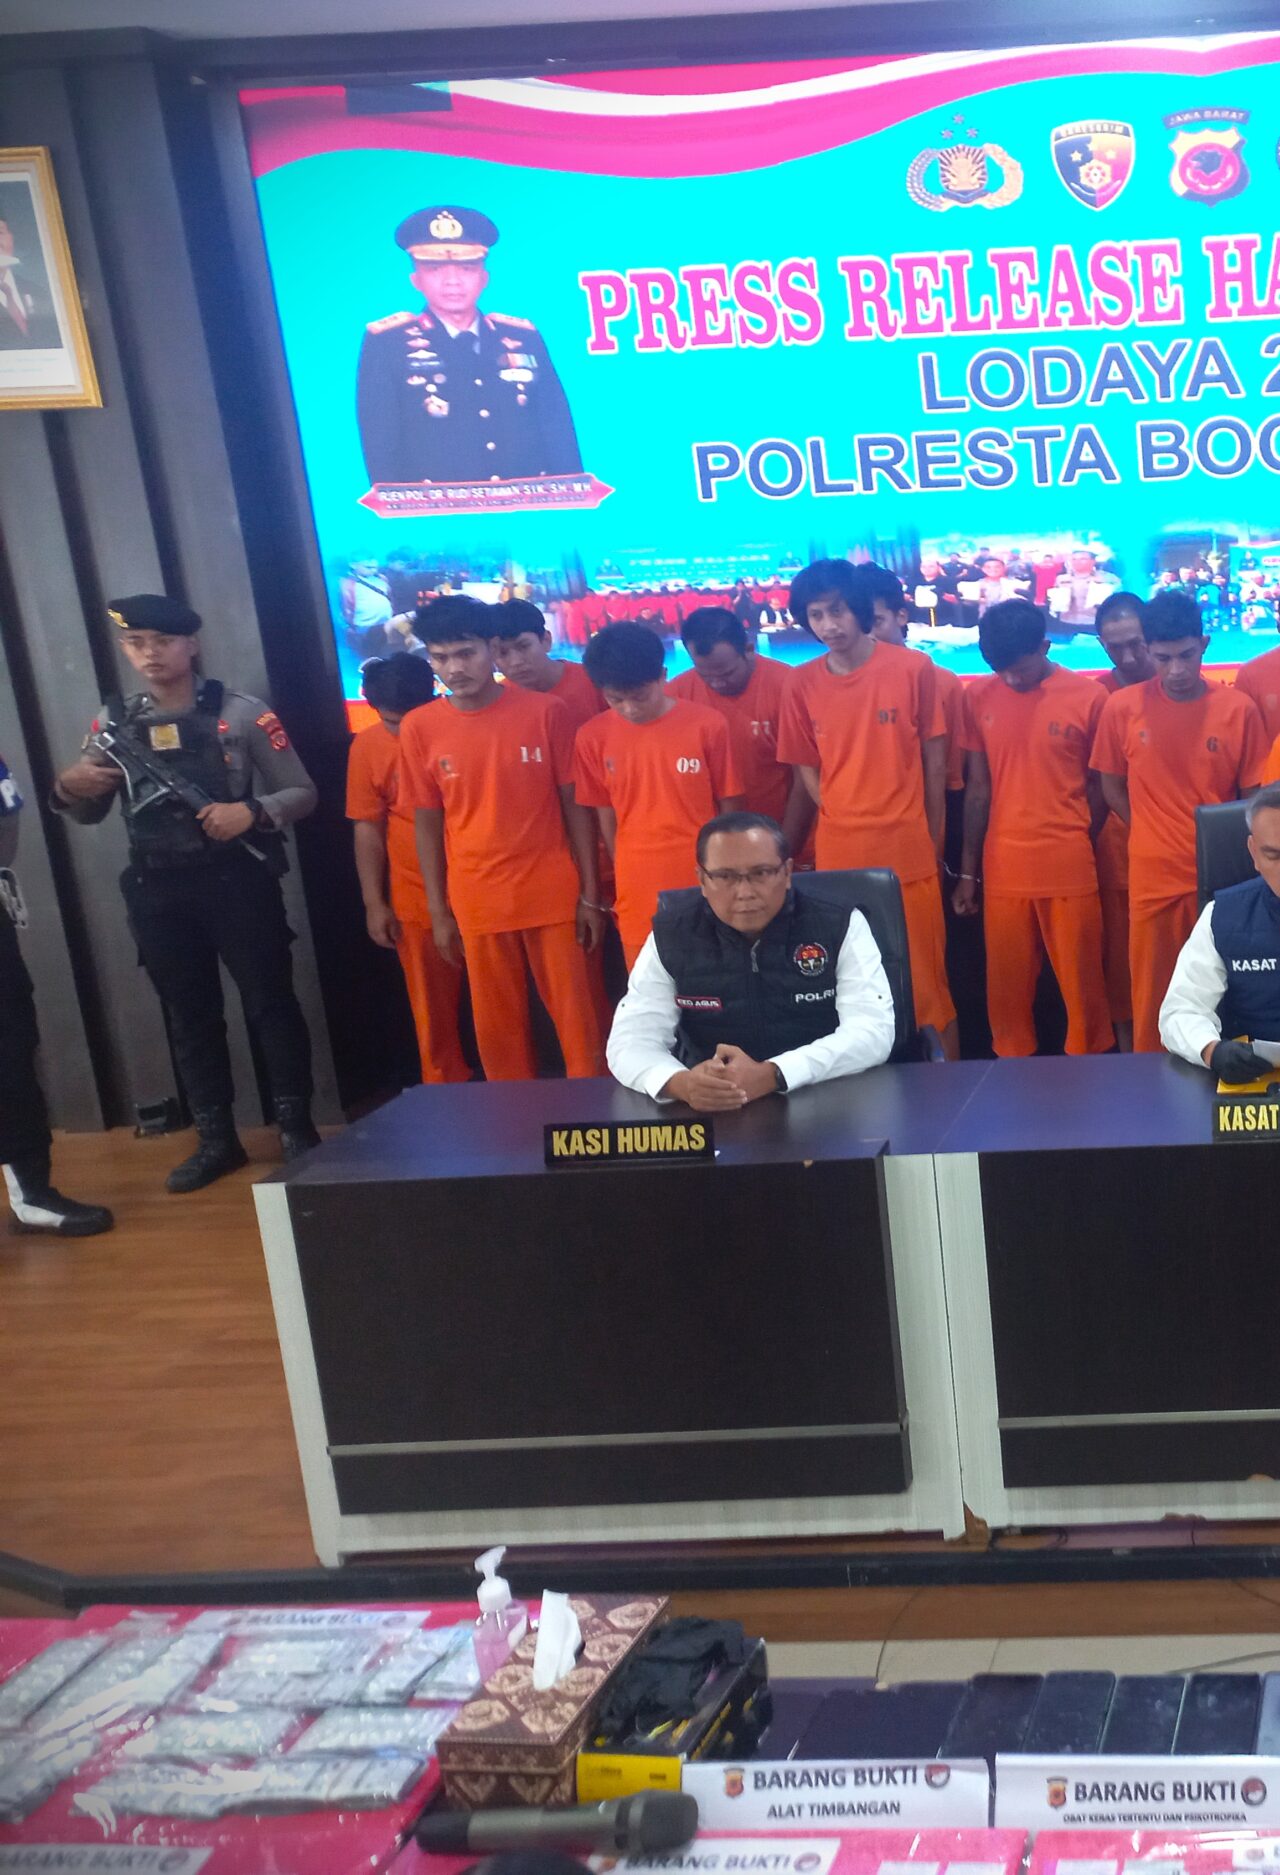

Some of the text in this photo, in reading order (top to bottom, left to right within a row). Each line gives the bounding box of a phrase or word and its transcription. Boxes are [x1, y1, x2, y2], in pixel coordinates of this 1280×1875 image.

[581, 257, 823, 353] PRESS
[838, 242, 1184, 341] RELEASE
[919, 338, 1244, 413] LODAYA
[694, 424, 1119, 502] POLRESTA
[520, 746, 542, 763] 14
[676, 757, 701, 773] 09
[1232, 958, 1277, 972] KASAT
[1219, 1105, 1279, 1132] KASAT
[552, 1123, 706, 1157] KASI HUMAS
[753, 1764, 918, 1791] BARANG BUKTI
[1074, 1780, 1236, 1802] BARANG BUKTI
[767, 1800, 901, 1820] ALAT TIMBANGAN
[1163, 1813, 1182, 1822] DAN
[624, 1852, 790, 1871] BARANG BUKTI
